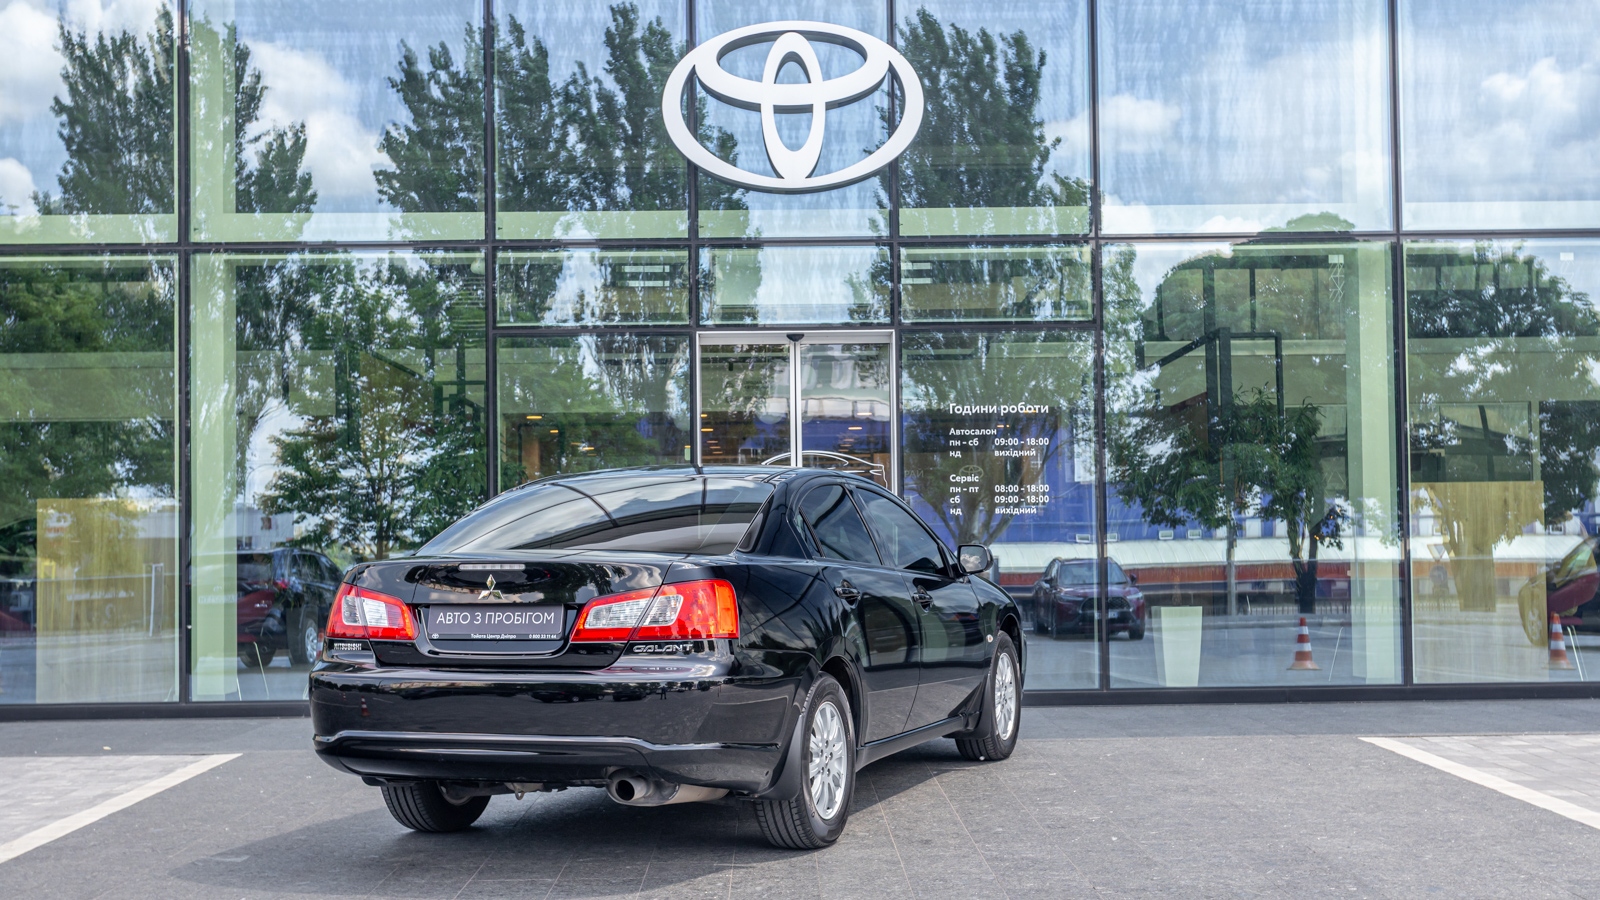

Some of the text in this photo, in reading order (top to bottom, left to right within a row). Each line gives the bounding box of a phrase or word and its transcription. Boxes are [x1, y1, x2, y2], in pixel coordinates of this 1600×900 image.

[949, 402, 1049, 416] Години роботи
[949, 428, 997, 436] Автосалон
[968, 438, 979, 446] сб
[994, 437, 1019, 446] 09:00
[1026, 437, 1050, 446] 18:00
[949, 448, 1036, 458] нд вихідний
[949, 474, 979, 484] Сервіс
[994, 484, 1019, 493] 08:00
[1026, 484, 1050, 493] 18:00
[949, 495, 961, 504] сб
[994, 495, 1019, 503] 09:00
[1026, 495, 1050, 503] 18:00
[950, 506, 1037, 516] нд вихідний
[436, 612, 471, 624] АВТО
[485, 612, 555, 624] ПРОБІГОМ
[333, 642, 362, 651] MITSUBISHI
[632, 643, 694, 653] GALANT
